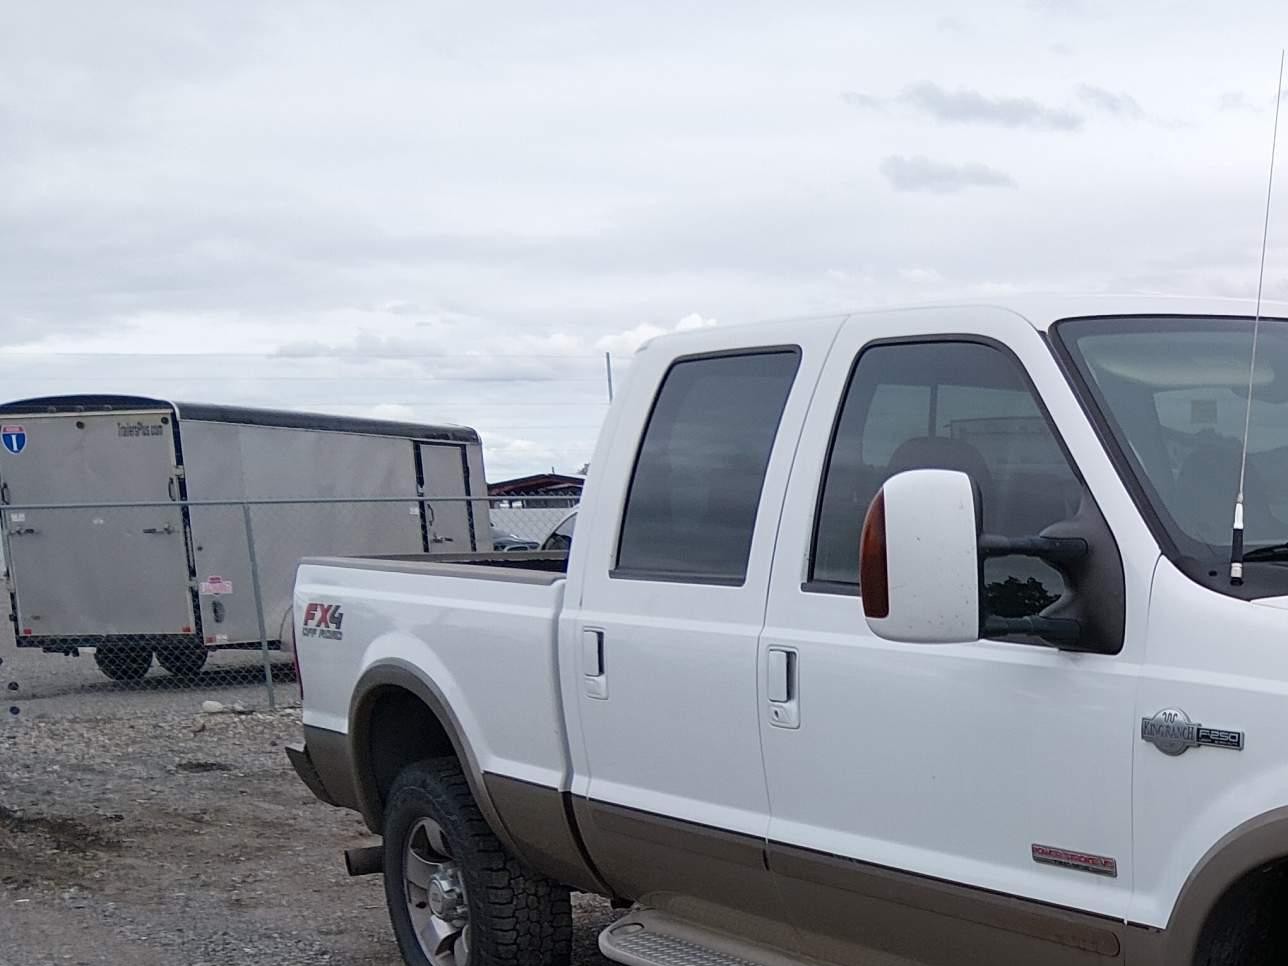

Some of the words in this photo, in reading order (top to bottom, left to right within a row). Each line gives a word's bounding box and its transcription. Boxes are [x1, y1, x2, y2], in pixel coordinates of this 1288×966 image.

[303, 603, 344, 629] FX4
[303, 628, 317, 639] OFF
[318, 629, 343, 640] ROAD
